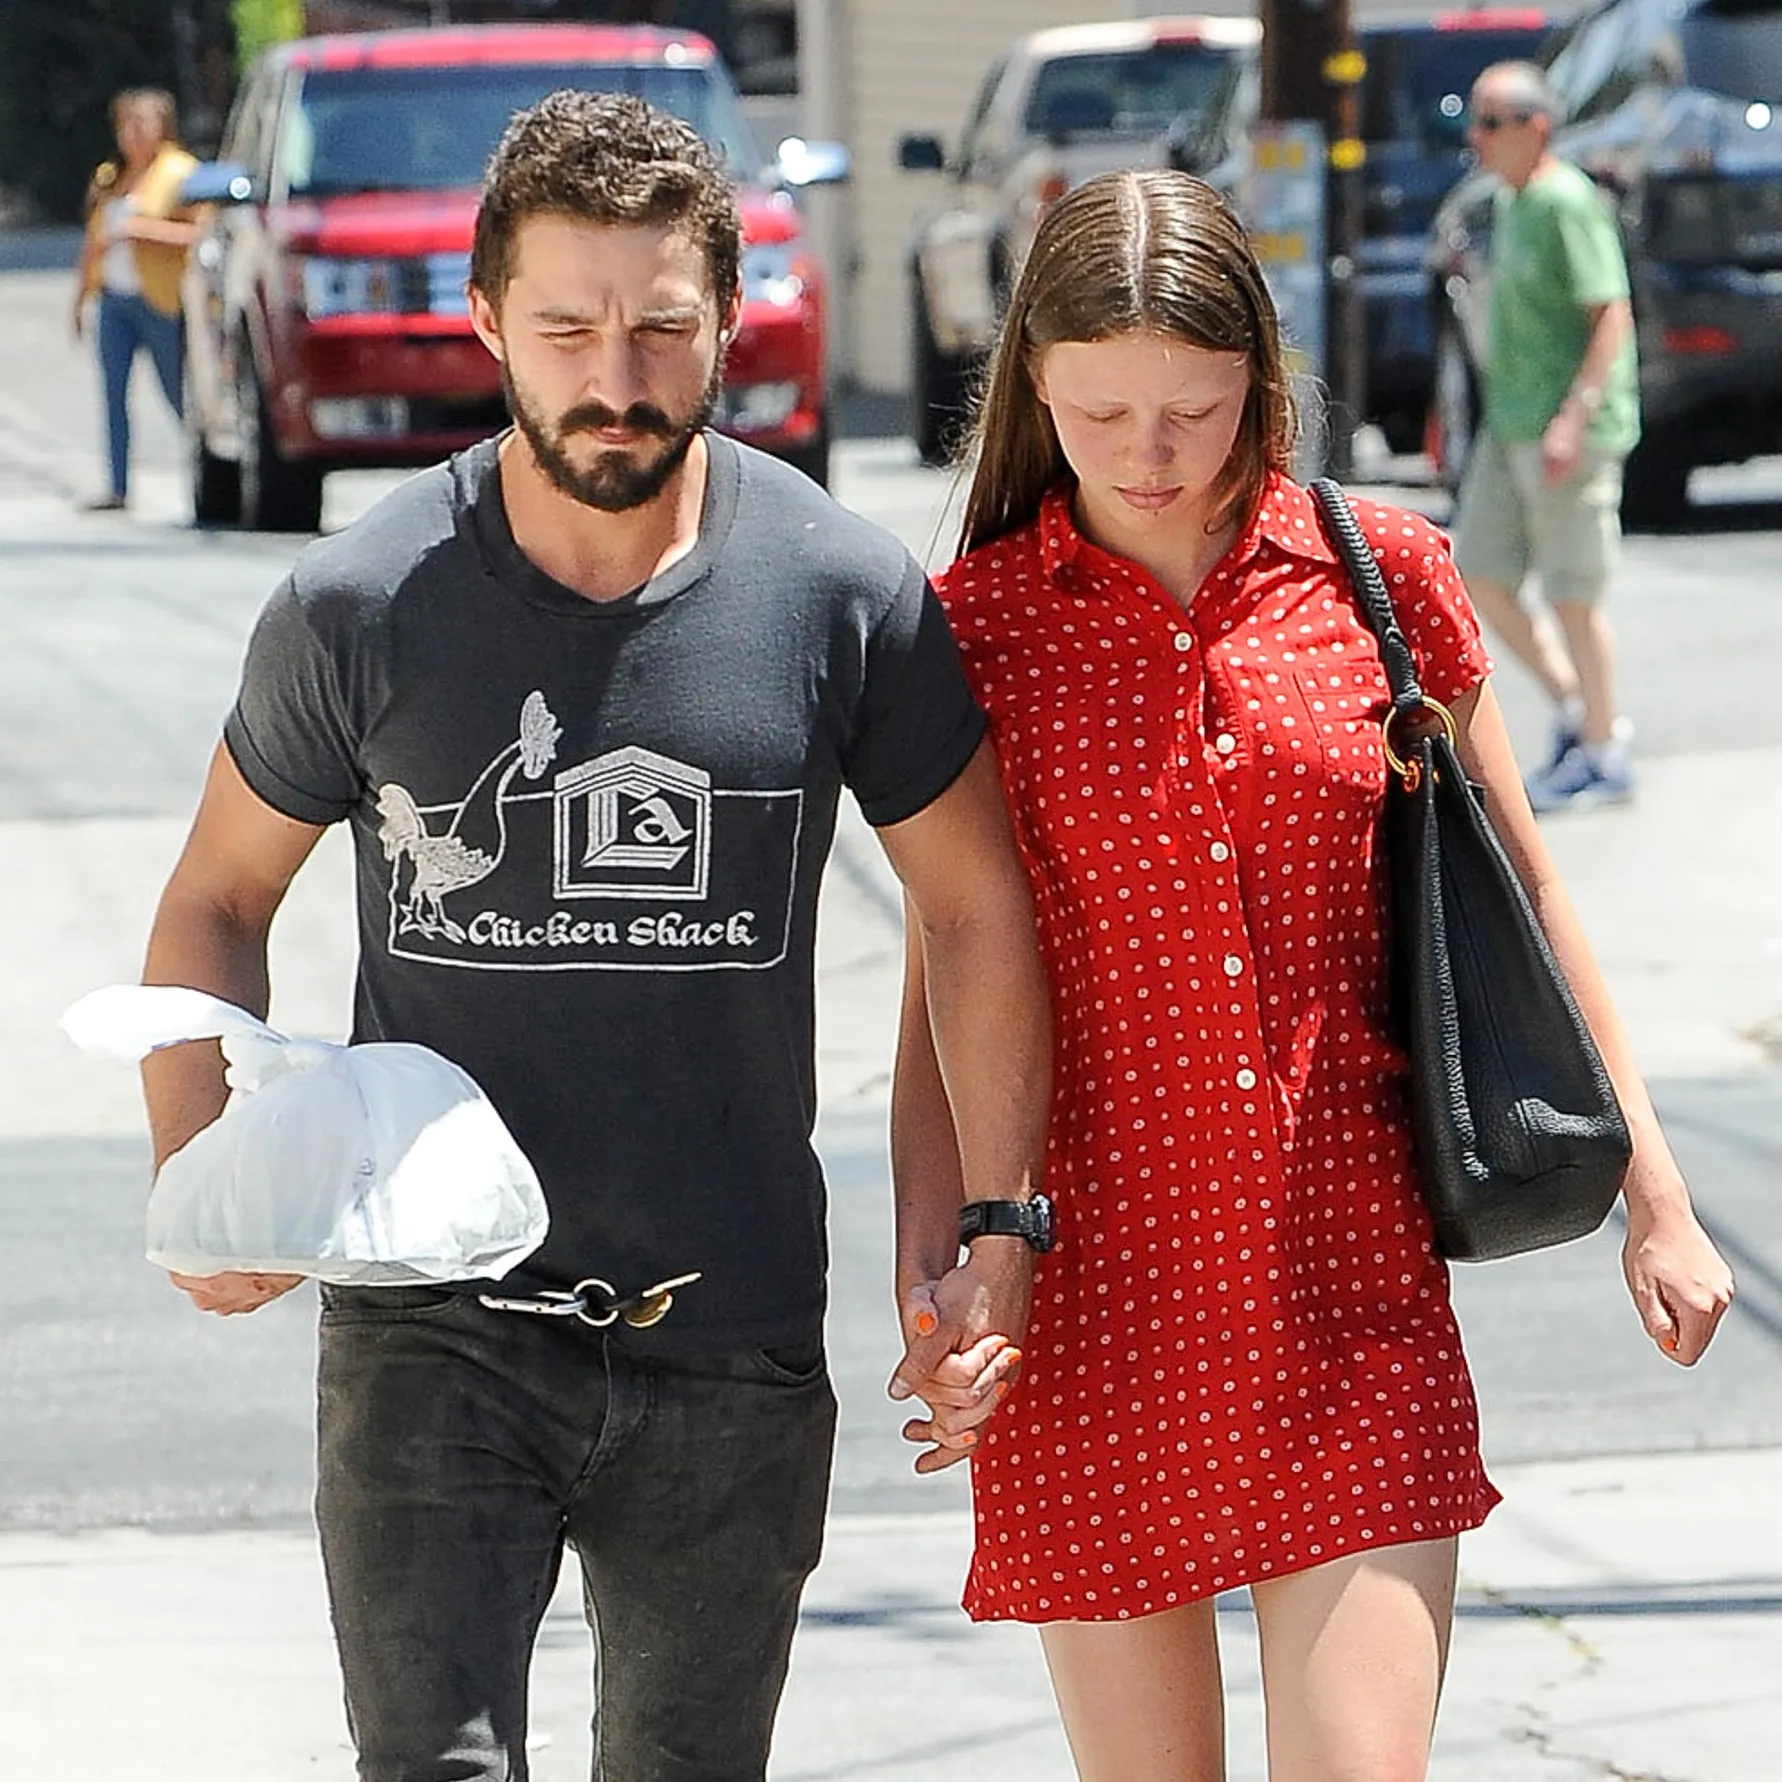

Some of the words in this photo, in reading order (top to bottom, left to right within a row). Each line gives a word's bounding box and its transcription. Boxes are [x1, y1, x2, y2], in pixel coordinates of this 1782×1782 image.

[582, 781, 693, 869] La
[468, 912, 618, 946] Chicken
[628, 911, 758, 946] Shack
